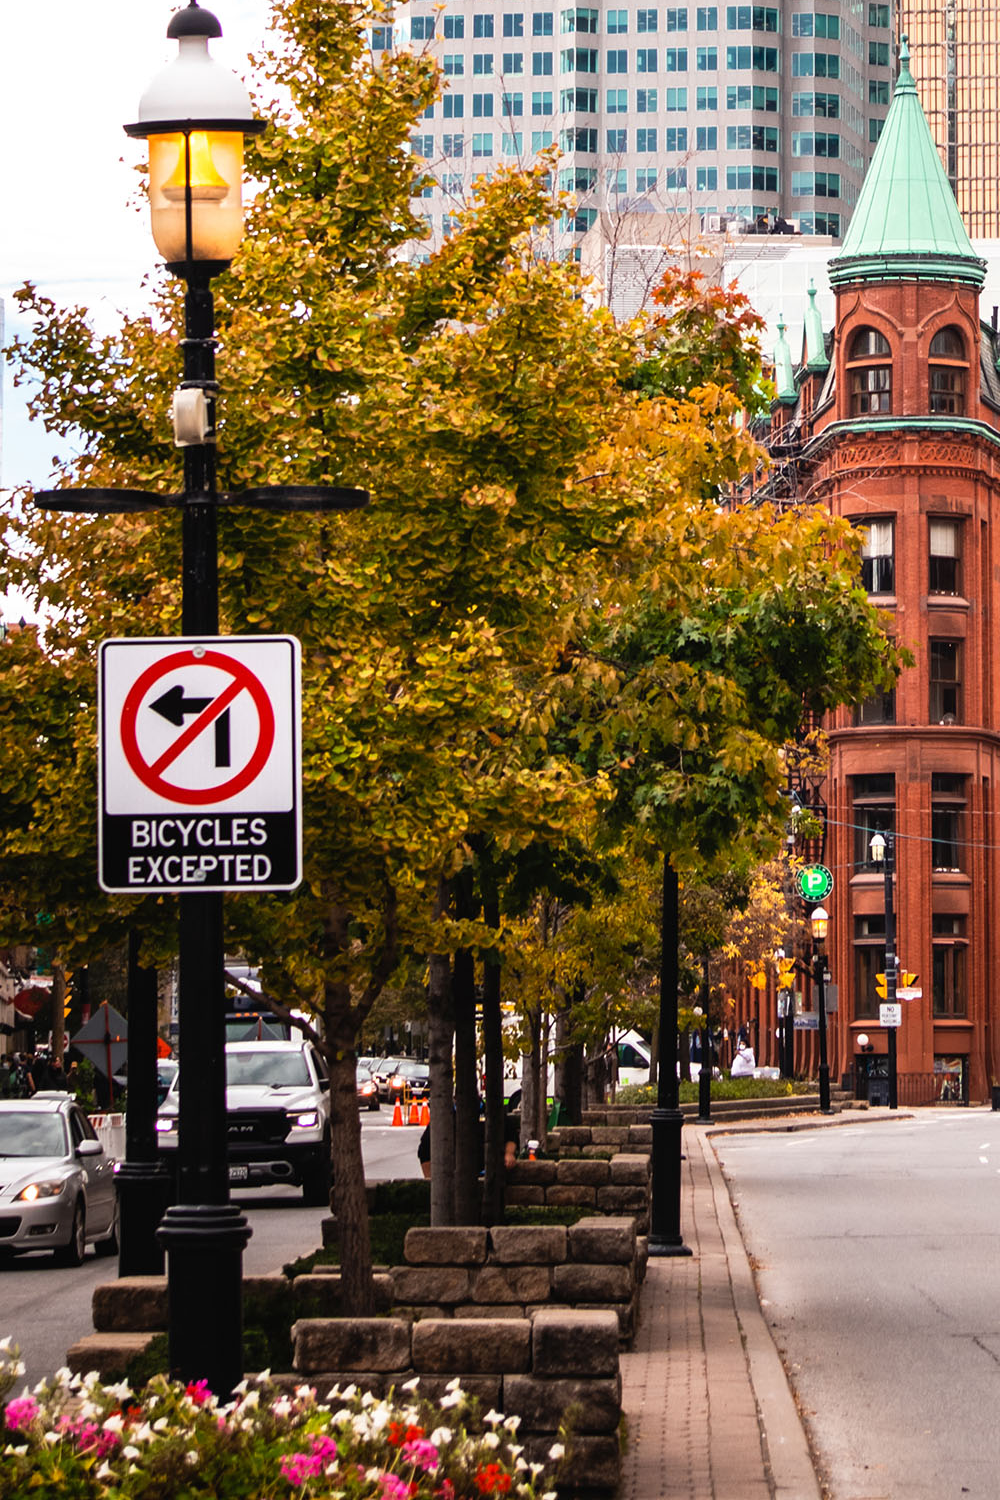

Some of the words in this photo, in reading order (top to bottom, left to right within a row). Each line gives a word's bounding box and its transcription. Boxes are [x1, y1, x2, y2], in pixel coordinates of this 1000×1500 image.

[131, 818, 267, 848] BICYCLES
[128, 854, 272, 884] EXCEPTED
[808, 873, 822, 889] P
[227, 1125, 254, 1133] AM
